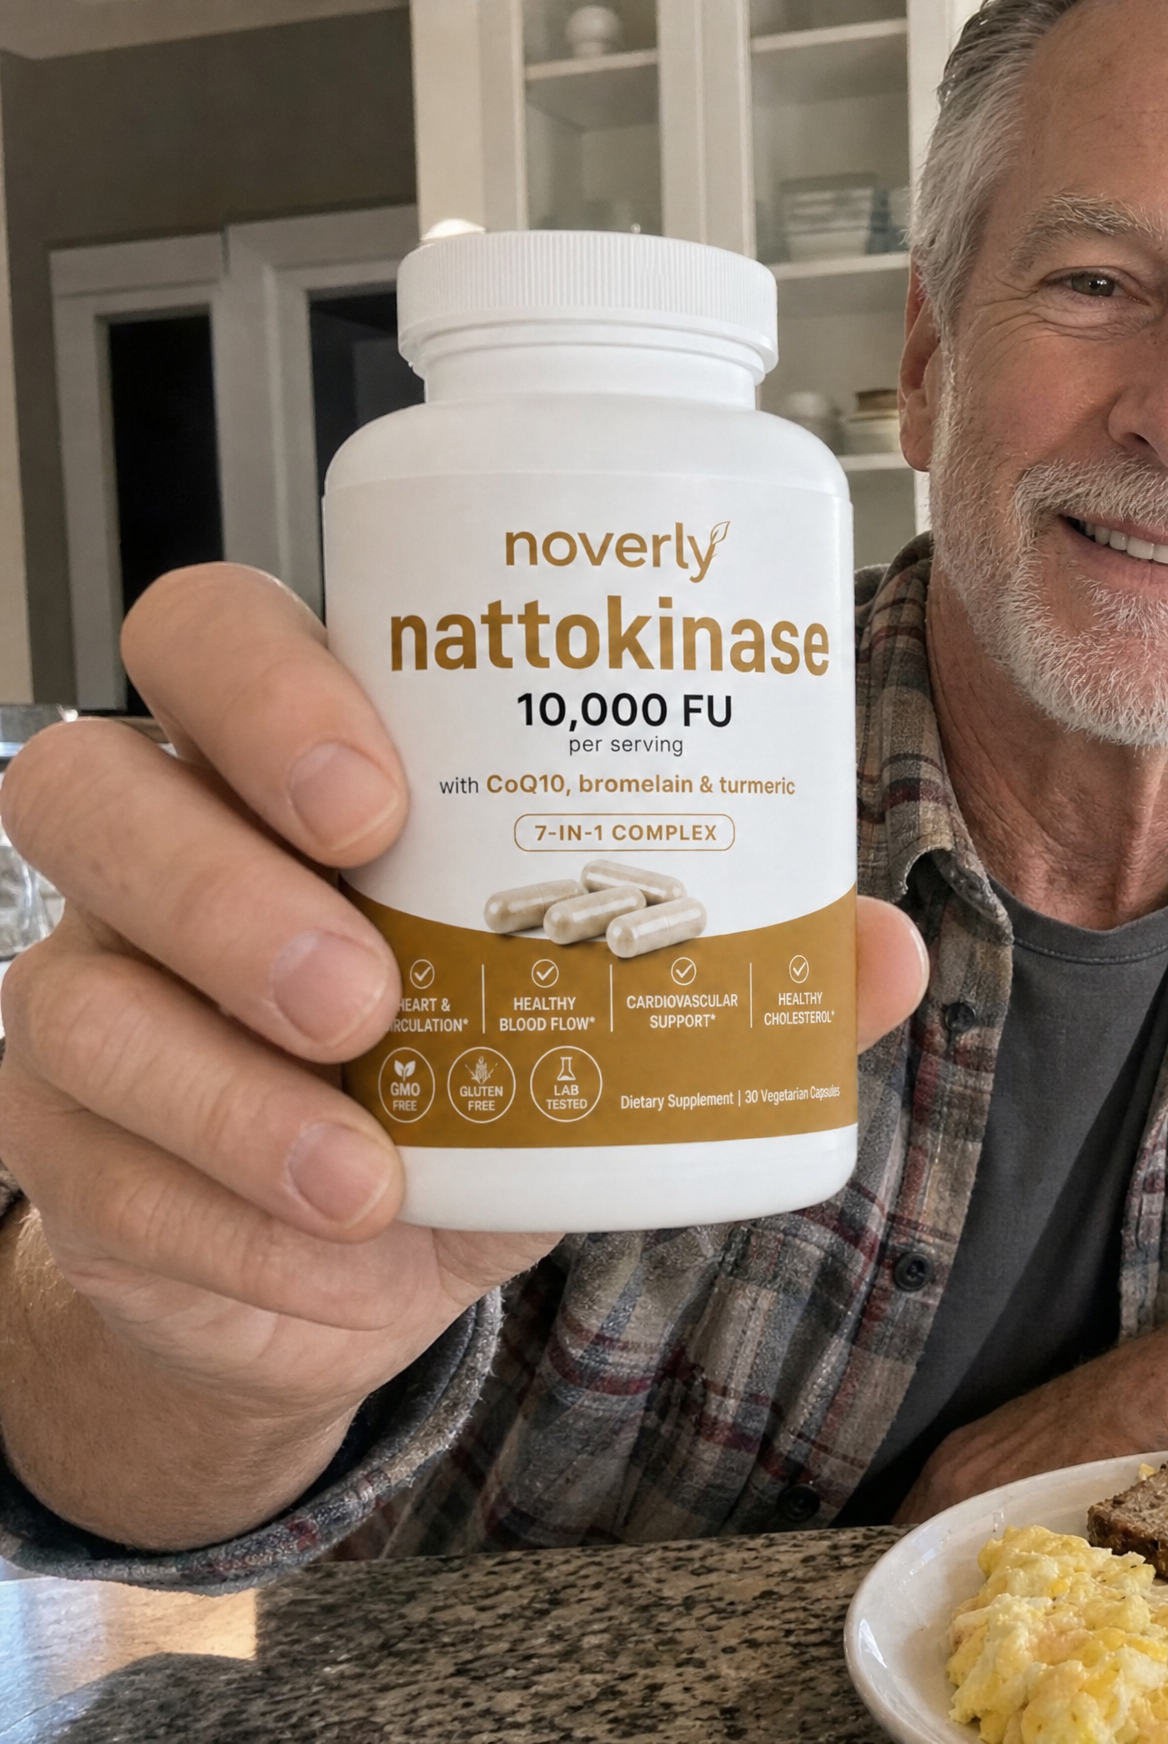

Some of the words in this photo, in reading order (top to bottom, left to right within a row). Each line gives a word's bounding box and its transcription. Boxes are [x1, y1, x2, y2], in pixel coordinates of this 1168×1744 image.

[505, 521, 730, 584] noverly
[390, 595, 829, 676] nattokinase
[517, 692, 668, 732] 10,000
[684, 694, 732, 727] FU
[569, 738, 602, 756] per
[610, 736, 684, 757] serving
[439, 776, 479, 795] with
[487, 774, 572, 797] CoQ10,
[579, 774, 693, 793] bromelain
[700, 776, 713, 793] &
[719, 776, 796, 795] turmeric
[535, 824, 603, 842] 7-IN-1
[612, 825, 717, 841] COMPLEX
[441, 998, 451, 1012] &
[513, 997, 576, 1011] HEALTHY
[626, 993, 738, 1009] CARDIOVASCULAR
[778, 992, 823, 1006] HEALTHY
[499, 1018, 547, 1032] BLOOD
[390, 1082, 421, 1097] GMO
[459, 1085, 503, 1097] GLUTEN
[554, 1085, 579, 1096] LAB
[546, 1099, 588, 1110] TESTED
[620, 1094, 664, 1112] Dietary
[667, 1091, 734, 1110] Supplement
[745, 1090, 759, 1104] 30
[760, 1086, 809, 1105] Vegetarian
[810, 1084, 841, 1101] Capsules
[392, 1100, 417, 1112] FREE
[468, 1101, 495, 1111] FREE
